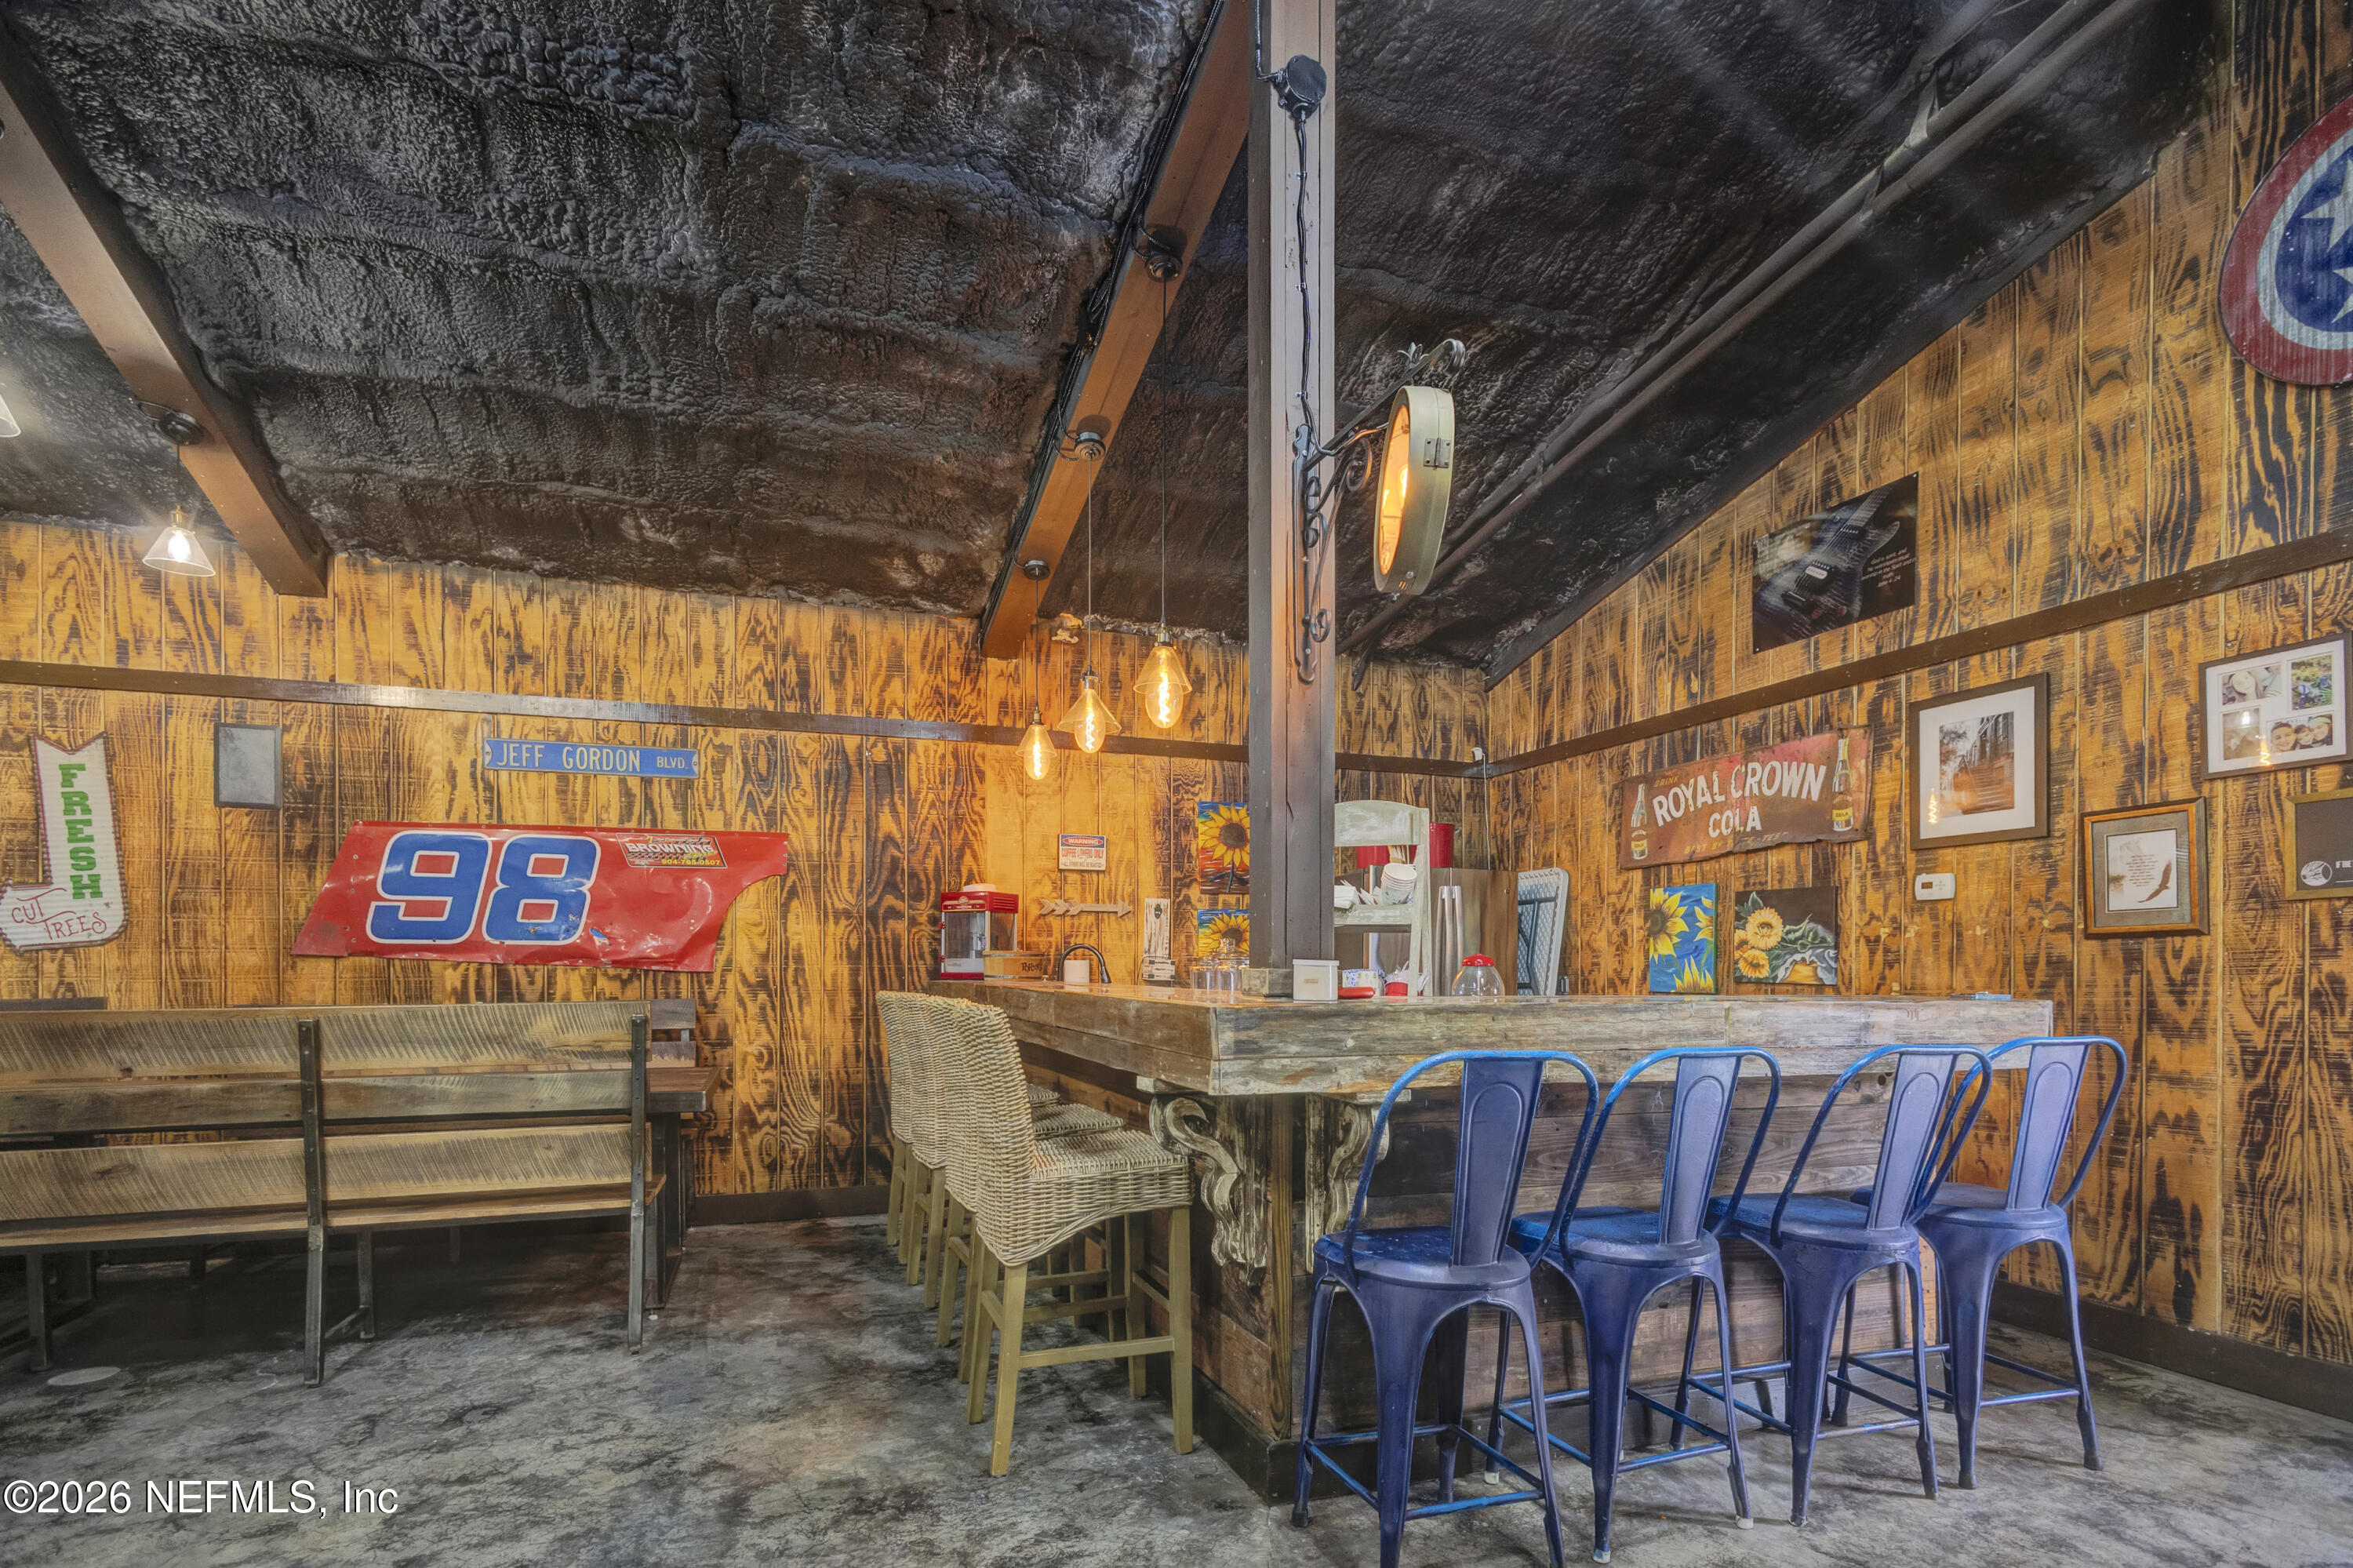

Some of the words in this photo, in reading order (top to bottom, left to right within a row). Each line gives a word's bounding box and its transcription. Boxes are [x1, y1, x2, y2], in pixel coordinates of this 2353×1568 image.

[496, 743, 545, 768] JEFF
[562, 746, 641, 773] GORDON
[1652, 771, 1726, 827] ROYAL
[1730, 760, 1827, 802] CROWN
[1654, 776, 1679, 788] DRINK
[58, 762, 104, 900] FRESH
[1708, 806, 1762, 838] COLA
[624, 842, 715, 853] BROWNING
[365, 830, 602, 946] 98
[11, 887, 67, 924] CUT
[25, 911, 107, 940] TREES
